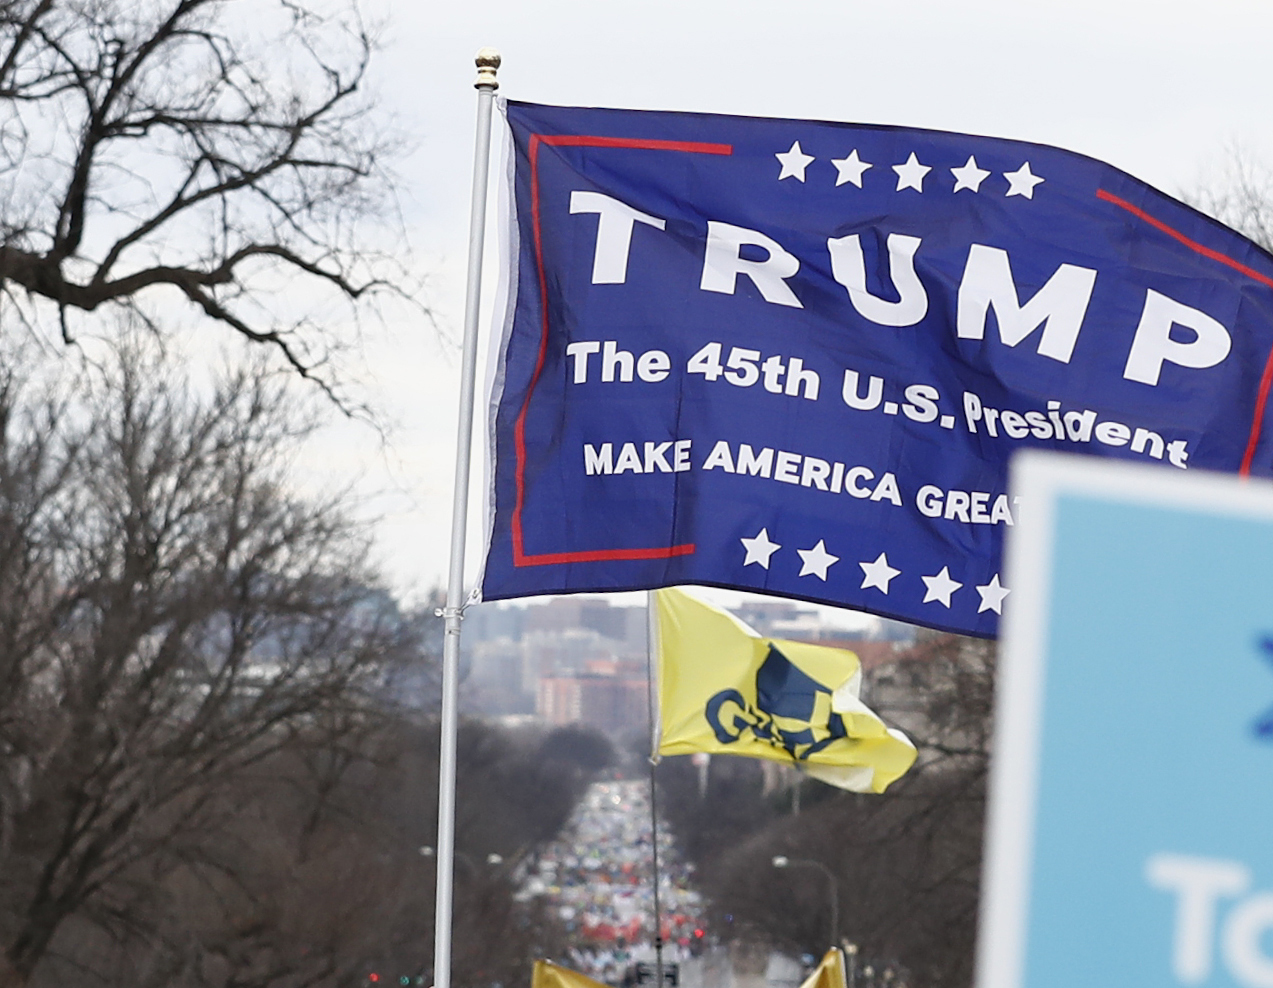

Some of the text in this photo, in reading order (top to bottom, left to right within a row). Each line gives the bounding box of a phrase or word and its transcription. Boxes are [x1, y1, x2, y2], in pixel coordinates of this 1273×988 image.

[568, 189, 1233, 387] TRUMP
[566, 340, 1189, 470] The 45th U.S. President
[584, 439, 1020, 527] MAKE AMERICA GREA
